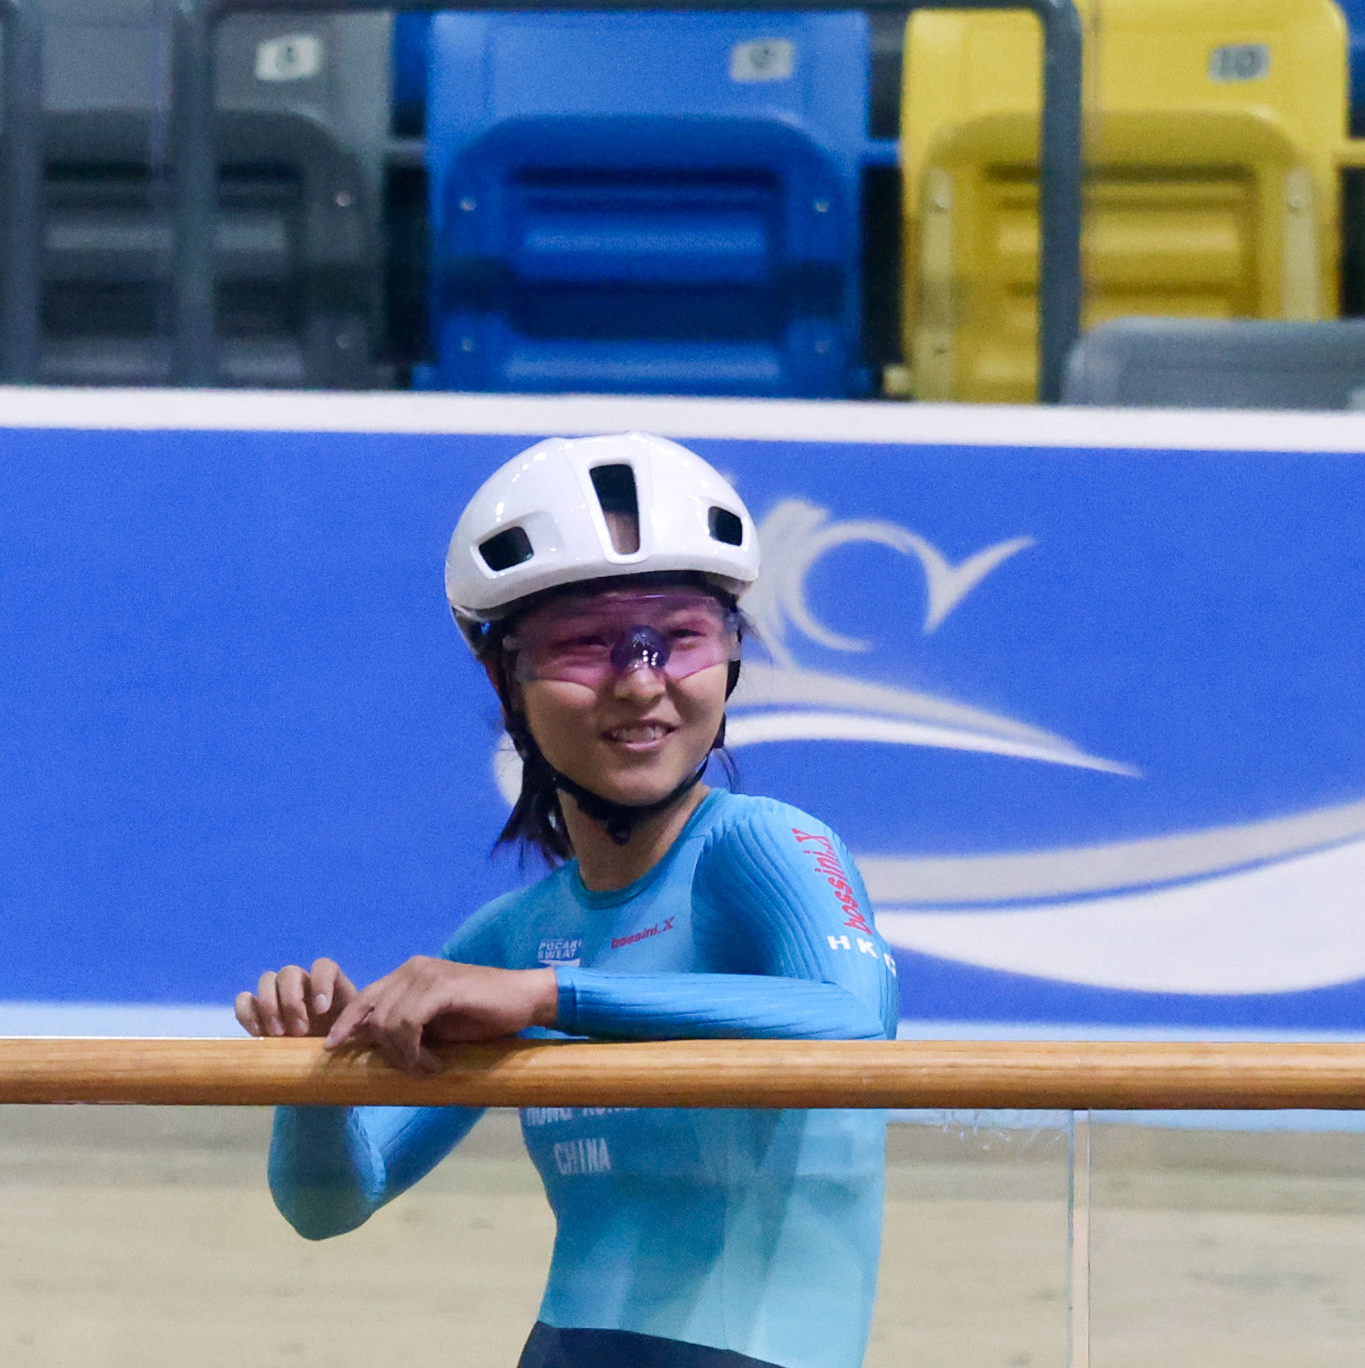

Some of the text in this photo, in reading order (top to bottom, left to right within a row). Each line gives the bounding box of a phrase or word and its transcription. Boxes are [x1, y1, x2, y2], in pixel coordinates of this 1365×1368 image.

[610, 916, 674, 950] bossini.X
[537, 949, 576, 960] SWEAT
[538, 939, 582, 950] POCARI
[553, 1137, 612, 1176] CHINA
